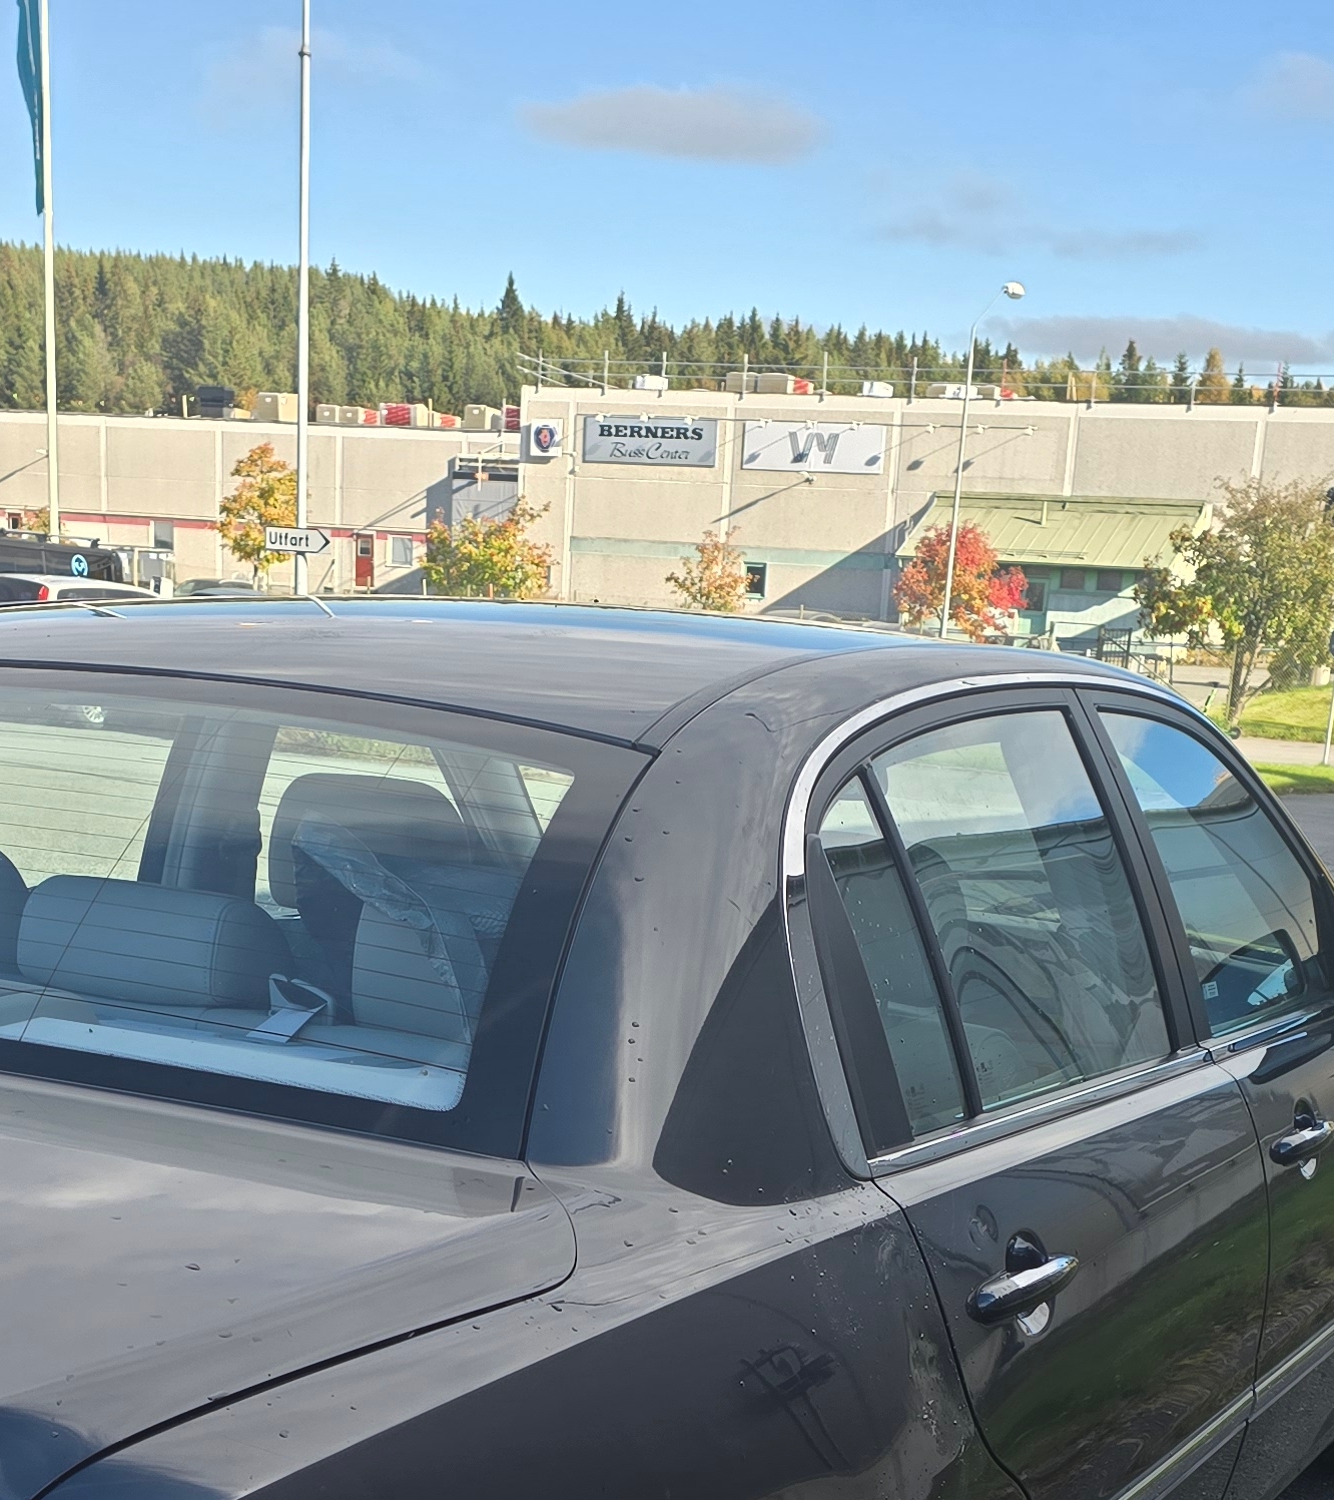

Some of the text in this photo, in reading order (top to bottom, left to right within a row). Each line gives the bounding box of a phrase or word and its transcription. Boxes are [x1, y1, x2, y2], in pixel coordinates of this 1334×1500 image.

[598, 424, 704, 441] BERNERS
[610, 442, 691, 460] Buss Center
[269, 531, 309, 547] Utfart
